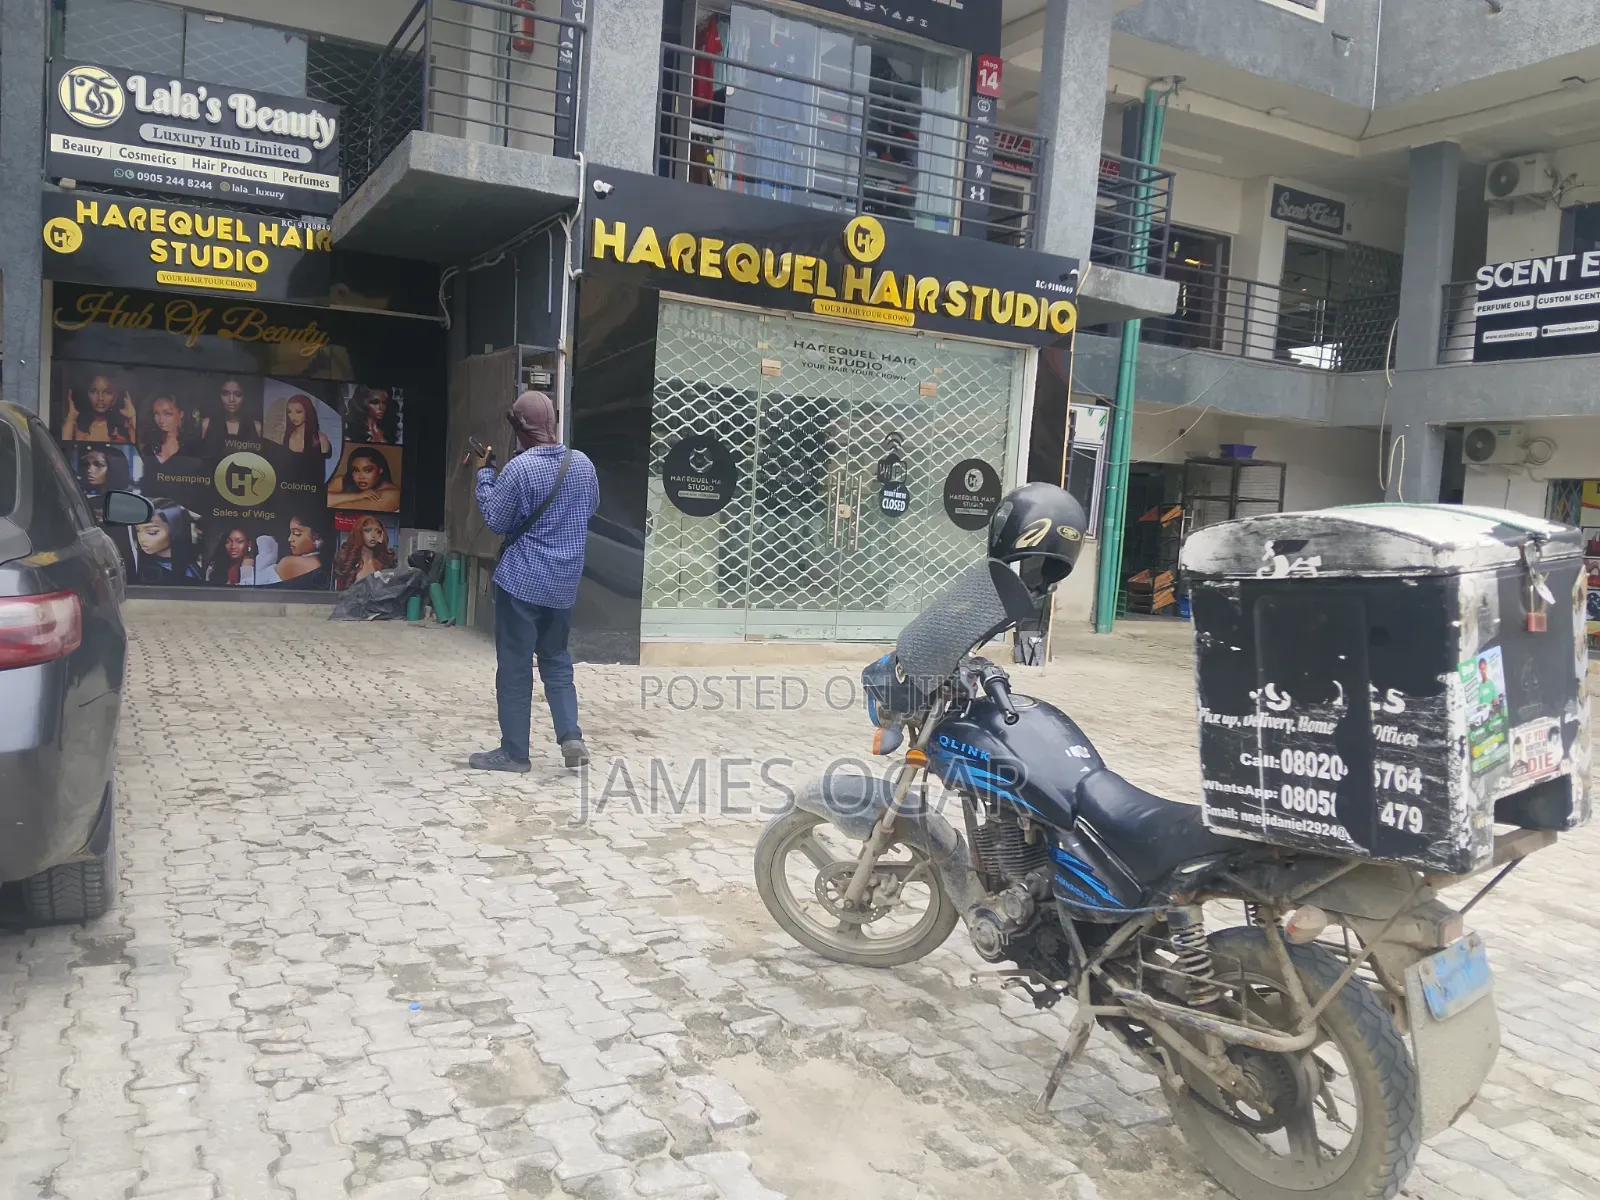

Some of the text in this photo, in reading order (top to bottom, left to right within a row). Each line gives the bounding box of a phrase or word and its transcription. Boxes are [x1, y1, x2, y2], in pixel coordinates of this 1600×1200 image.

[983, 60, 998, 70] shop
[980, 69, 998, 90] 14
[126, 75, 222, 123] Lala's
[227, 93, 336, 149] Beauty
[152, 127, 300, 160] Luxury Hub Limited
[62, 138, 330, 189] Beauty Cosmetics Hair Products Perfumes
[137, 171, 163, 184] 0905
[165, 175, 185, 187] 244
[187, 178, 213, 191] 8244
[76, 200, 333, 252] HAREQUEL HAIR
[149, 238, 269, 274] STUDIO
[161, 273, 253, 290] YOUR HAIR YOUR CROWN
[591, 216, 1077, 334] HAREQUEL HAIR STUDIO
[1475, 254, 1577, 291] SCENT
[819, 303, 841, 312] YOUR
[861, 309, 882, 319] YOUR
[882, 313, 910, 323] CROWN
[1477, 301, 1512, 313] PERFUME
[1513, 299, 1531, 308] OILS
[1538, 295, 1572, 305] CUSTOM
[54, 292, 331, 357] Hub Of Beauty
[793, 339, 918, 366] HAREQUEL HAIR
[801, 361, 906, 381] YOUR HAIR YOUR CROWN
[828, 355, 883, 371] STUDIO
[224, 438, 261, 451] Wigging
[157, 473, 211, 485] Revamping
[280, 481, 317, 492] Coloring
[687, 483, 714, 491] STUDIO
[212, 508, 276, 520] Sales of Wigs
[881, 498, 906, 511] CLOSED
[939, 735, 990, 762] QLINK
[1527, 752, 1553, 773] DIE
